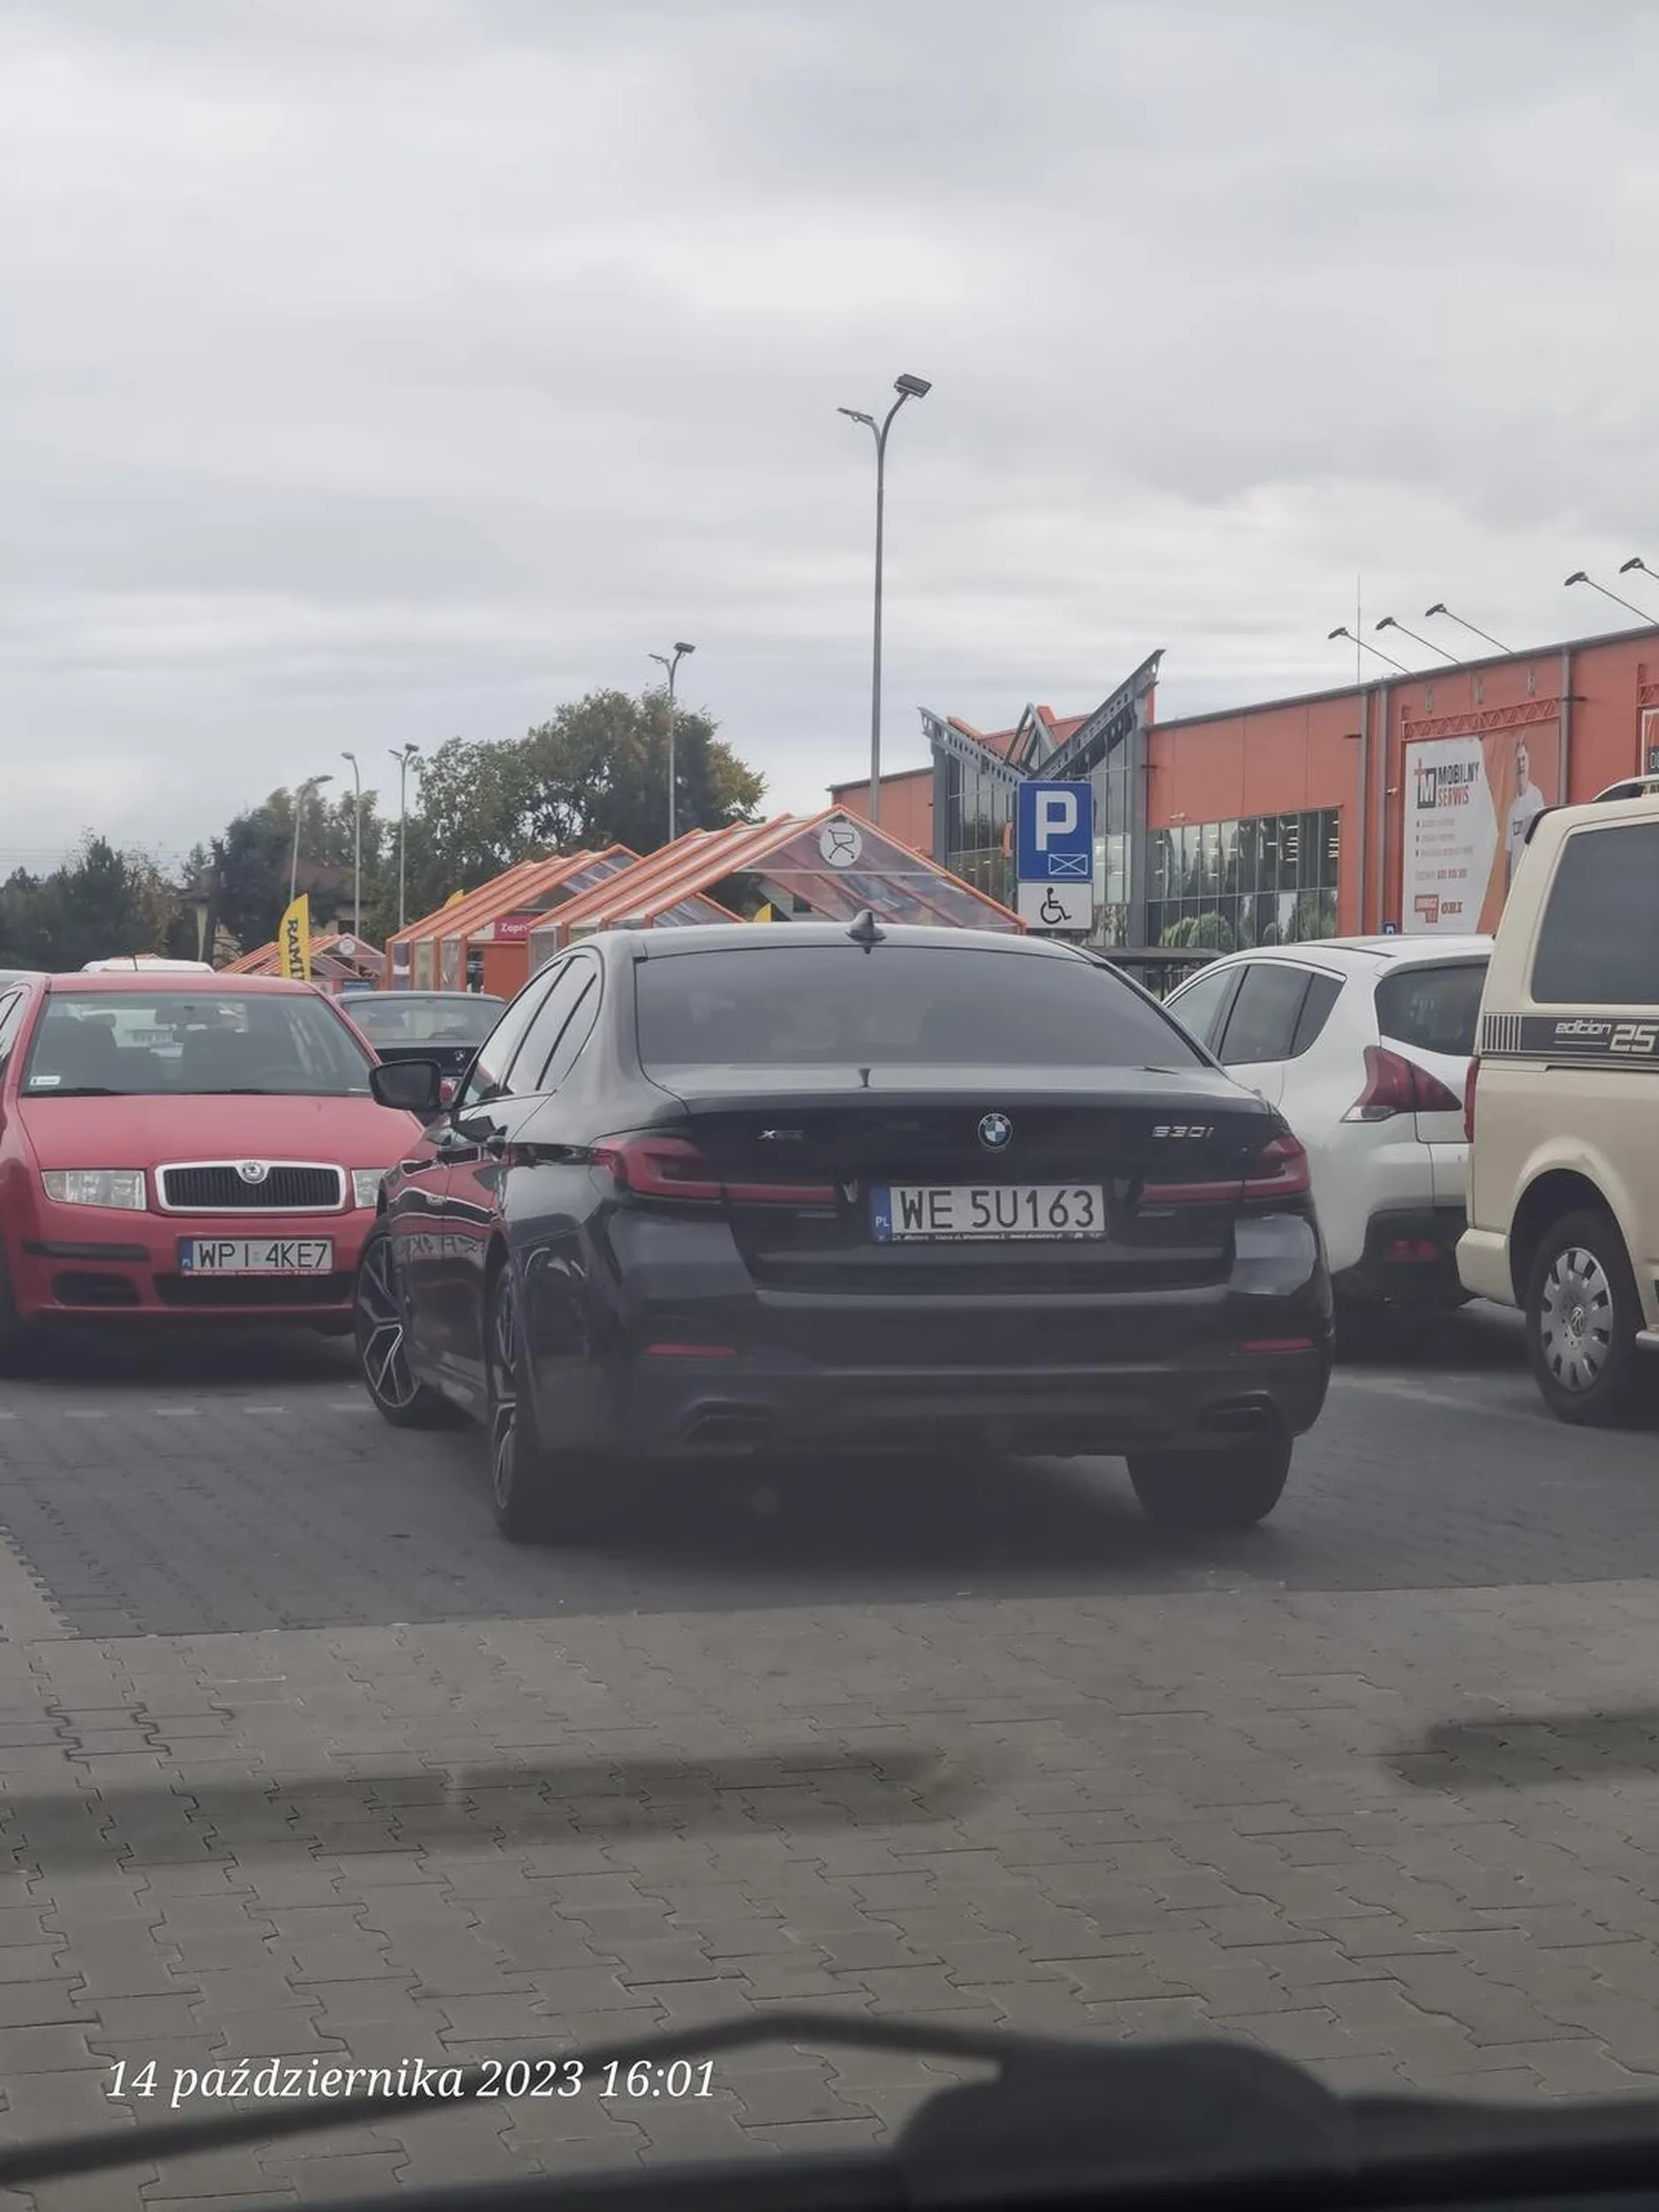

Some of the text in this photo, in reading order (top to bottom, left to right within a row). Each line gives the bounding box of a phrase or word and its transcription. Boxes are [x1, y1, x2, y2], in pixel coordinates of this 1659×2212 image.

[1438, 761, 1480, 786] MOBILNY
[1438, 785, 1470, 807] SERWIS
[1035, 790, 1078, 851] P
[1555, 1020, 1659, 1052] edition 25
[1151, 1125, 1215, 1139] 530i
[875, 1216, 890, 1227] PL
[899, 1188, 1094, 1230] WE 5U163
[198, 1241, 328, 1269] WPI 4KE7
